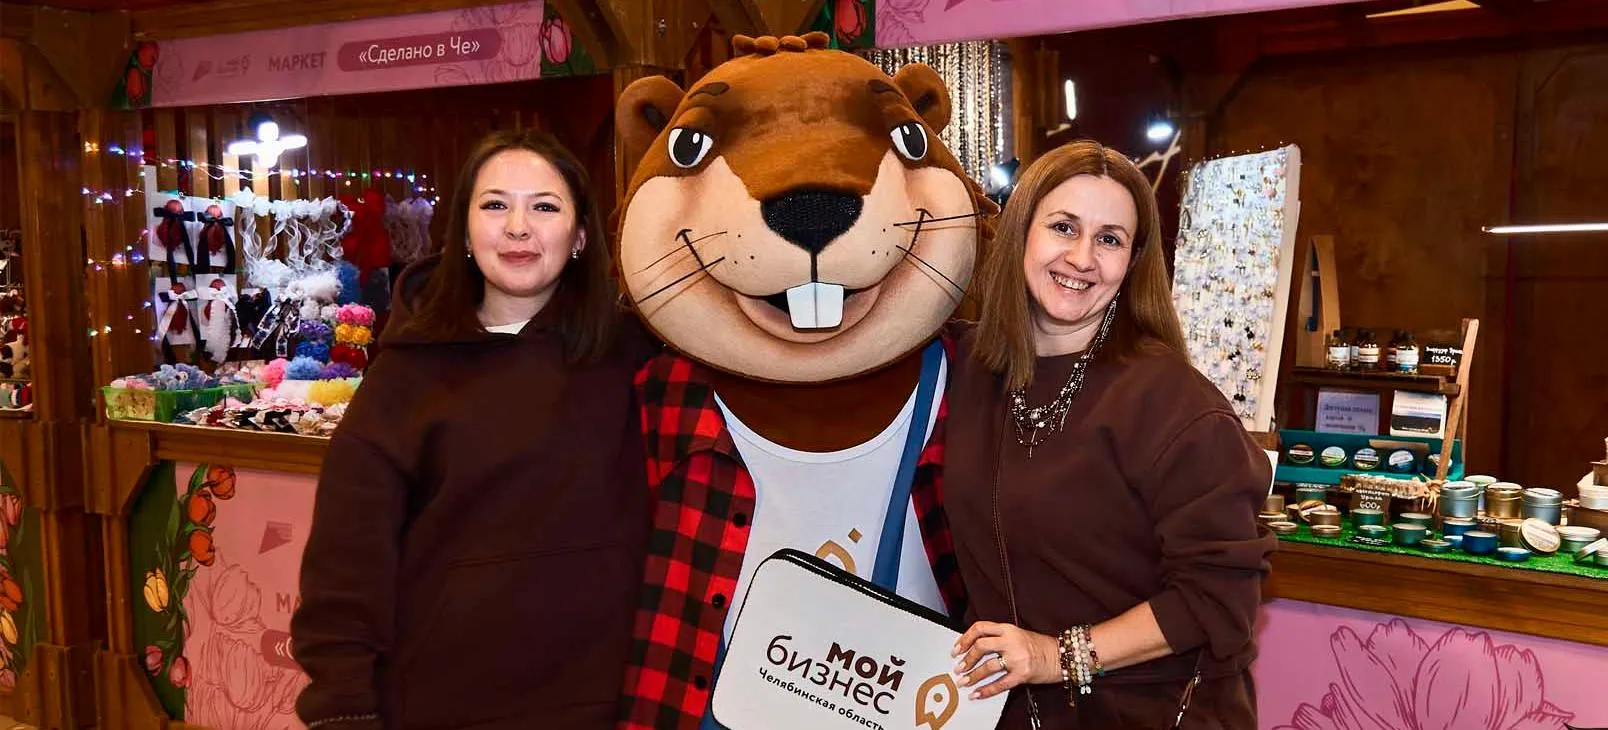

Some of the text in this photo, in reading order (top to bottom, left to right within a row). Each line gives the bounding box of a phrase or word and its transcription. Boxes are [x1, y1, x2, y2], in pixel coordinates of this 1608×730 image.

[268, 51, 327, 72] МАРКЕТ
[359, 36, 481, 64] «Сделано в Че»
[759, 666, 836, 711] Челябинская
[766, 635, 895, 715] бизнес
[826, 642, 906, 692] мой
